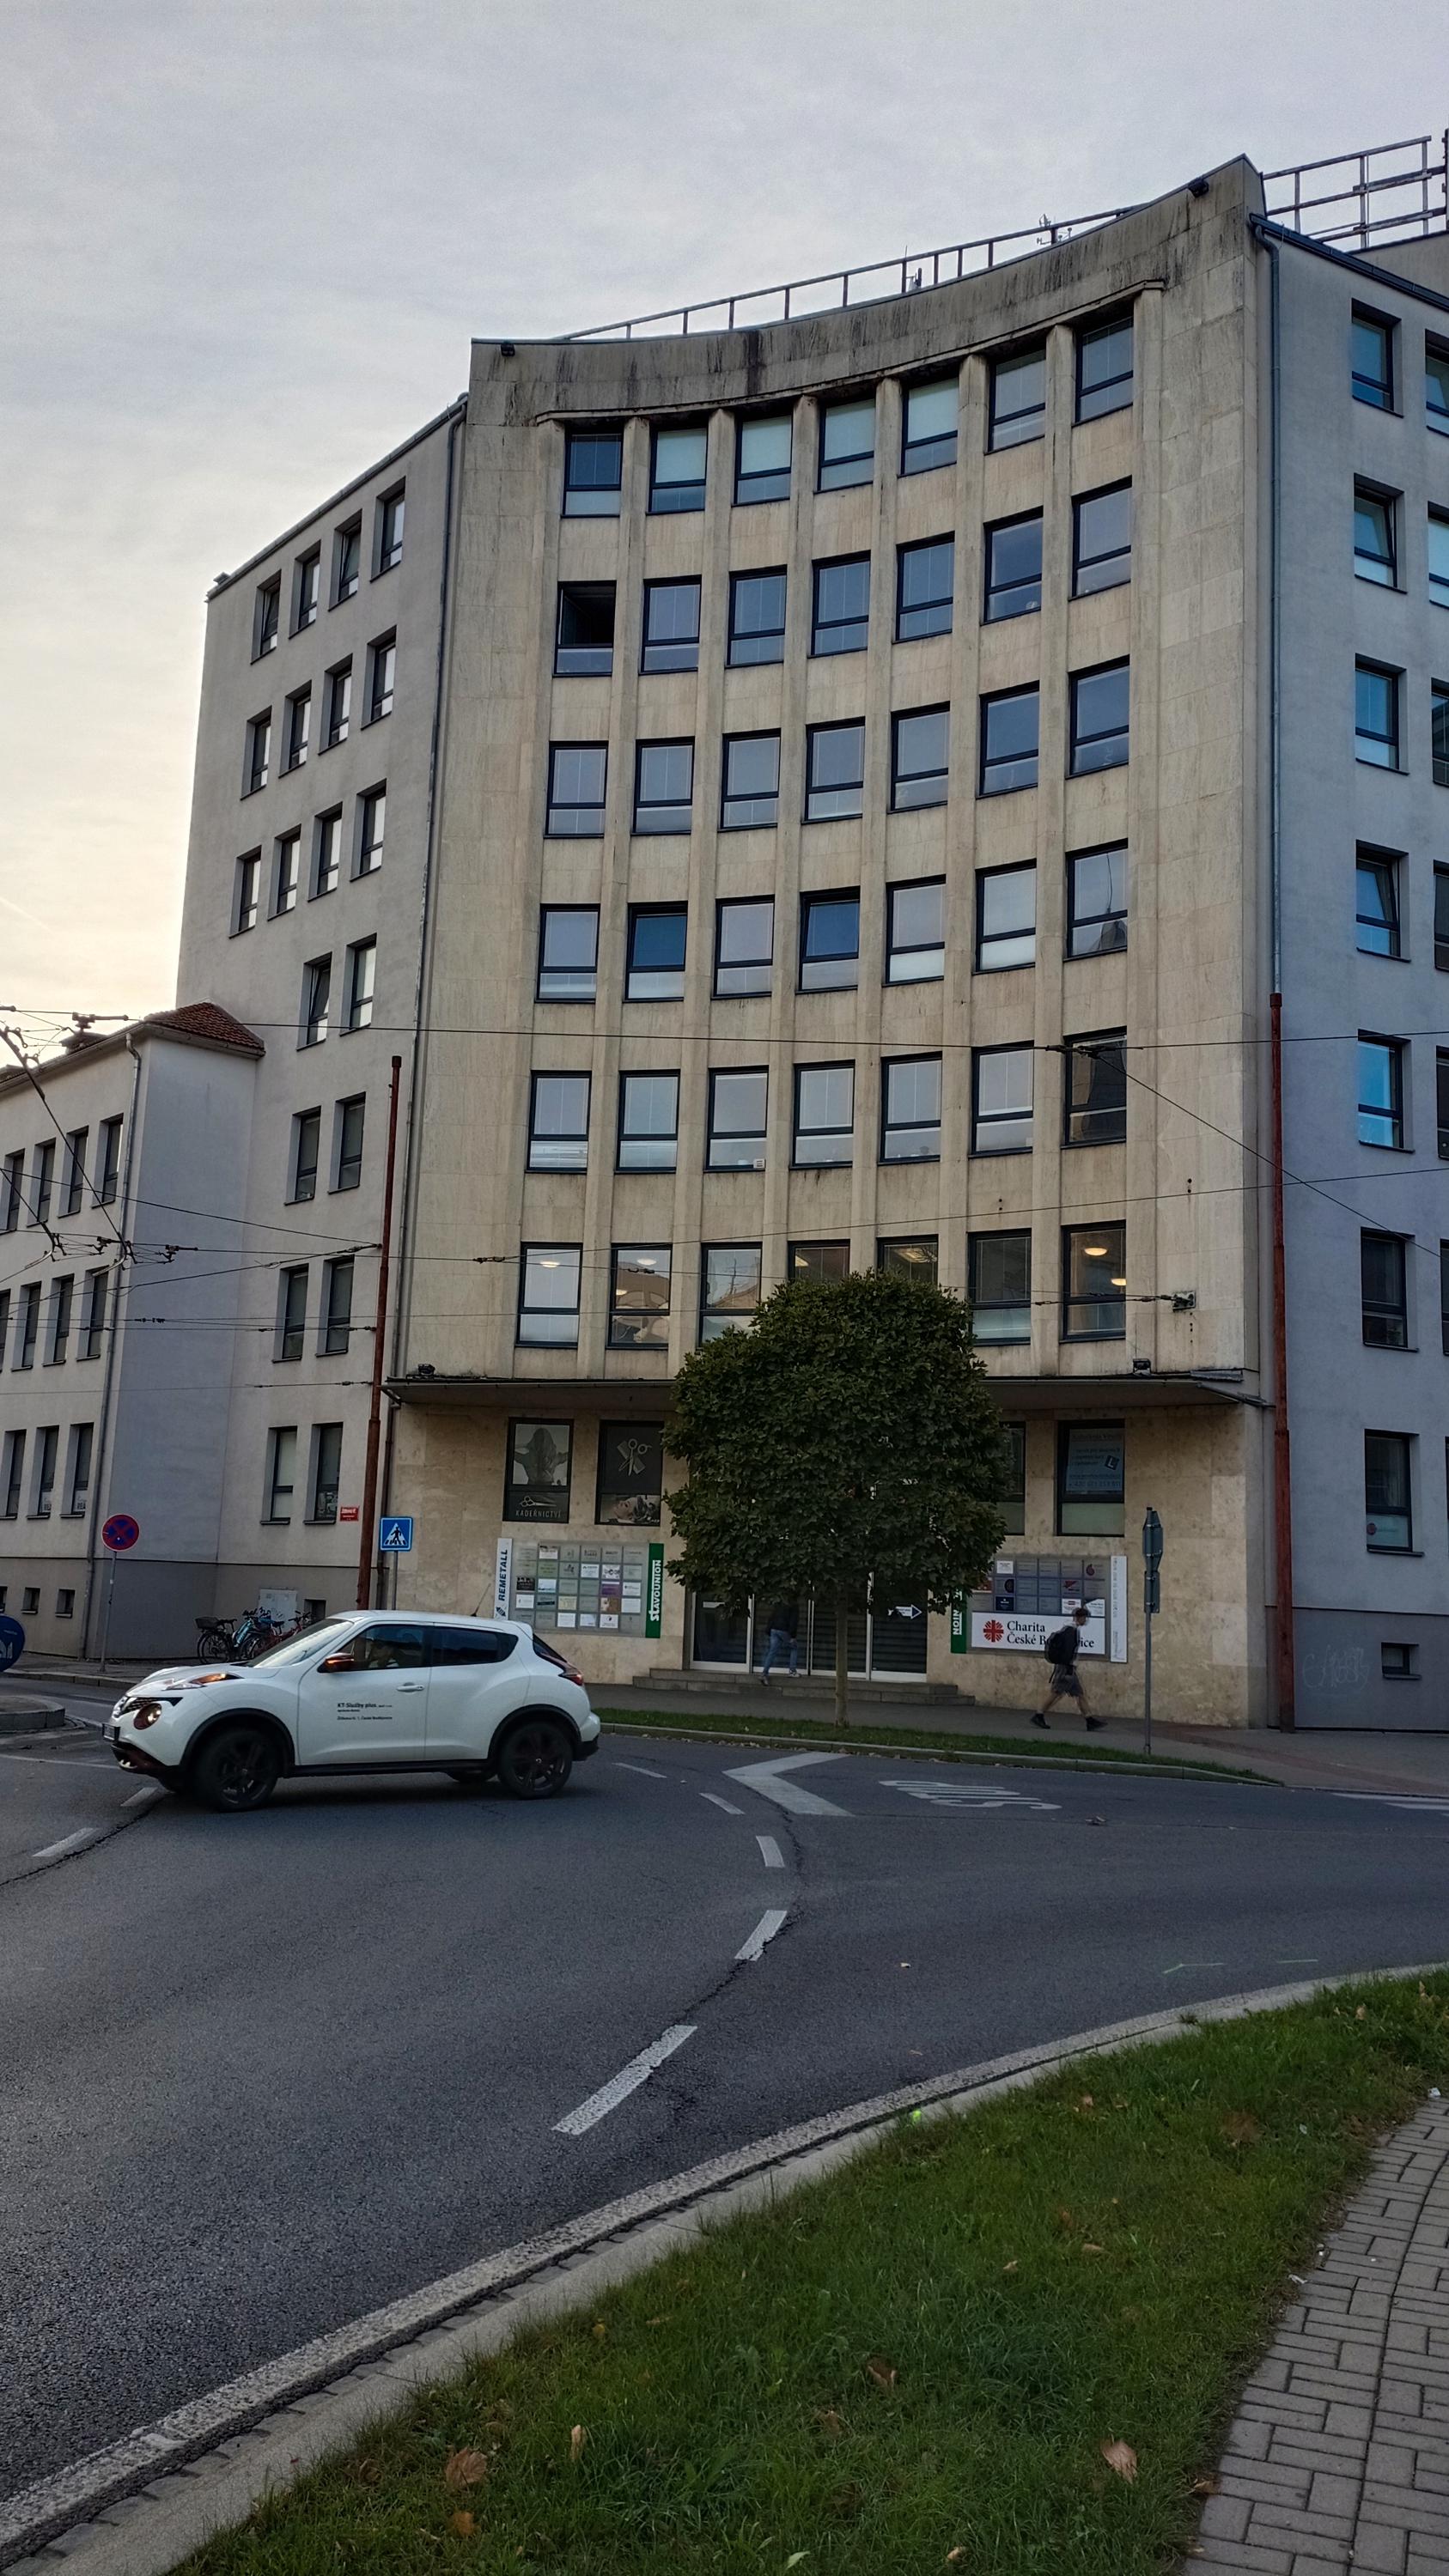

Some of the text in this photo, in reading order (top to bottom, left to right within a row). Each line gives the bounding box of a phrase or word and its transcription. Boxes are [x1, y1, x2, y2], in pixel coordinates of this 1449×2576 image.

[498, 1549, 508, 1601] REMETALL
[1007, 1620, 1045, 1632] Charita
[1007, 1631, 1037, 1645] České
[878, 1780, 1062, 1810] STOP
